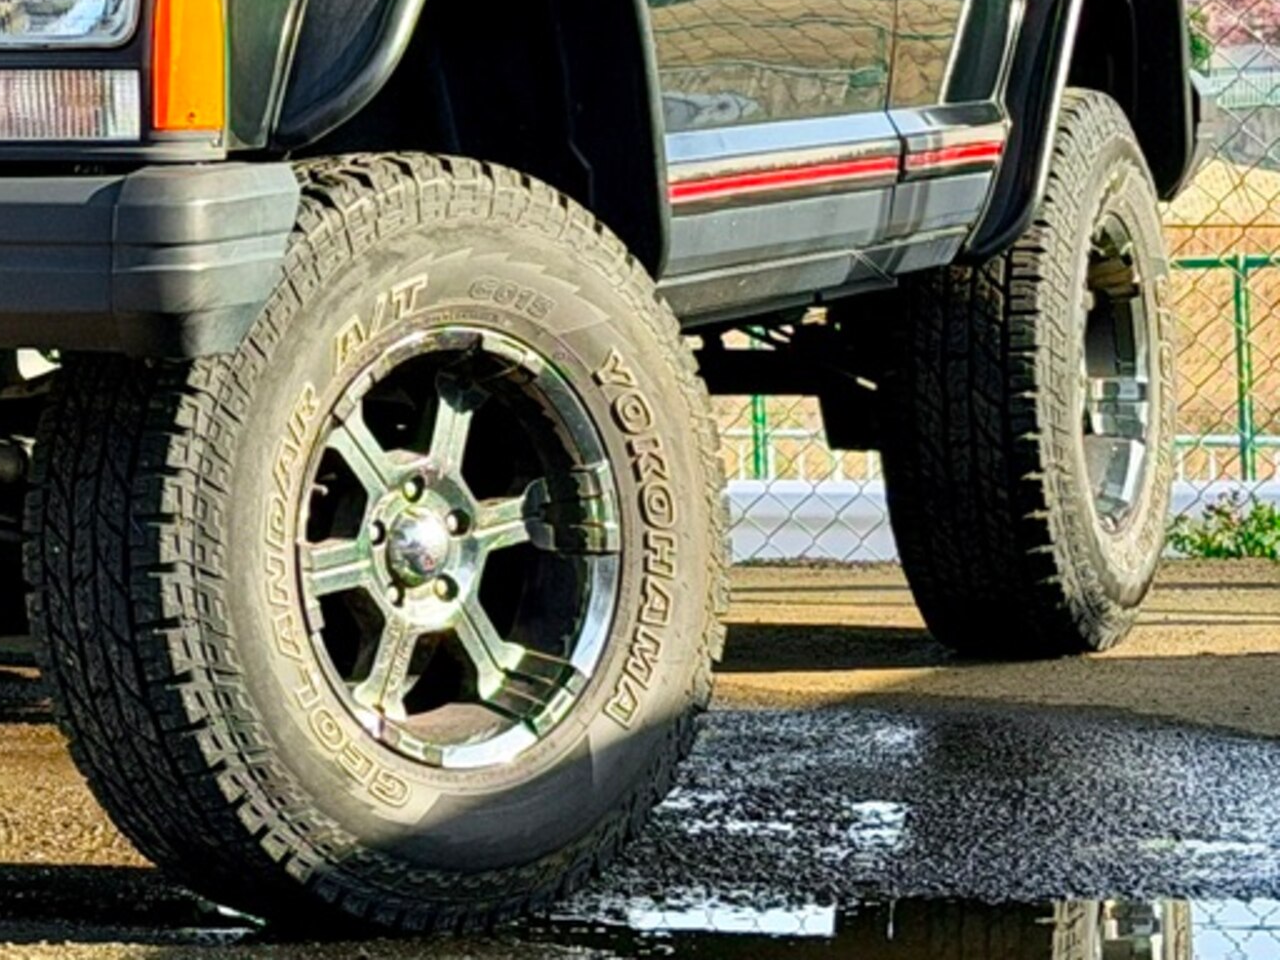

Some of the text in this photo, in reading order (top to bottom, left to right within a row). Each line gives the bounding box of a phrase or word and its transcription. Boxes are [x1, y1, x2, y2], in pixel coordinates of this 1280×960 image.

[333, 273, 428, 375] A/T
[264, 382, 411, 808] GEOLANDAR
[591, 346, 675, 730] YOKOHAMA
